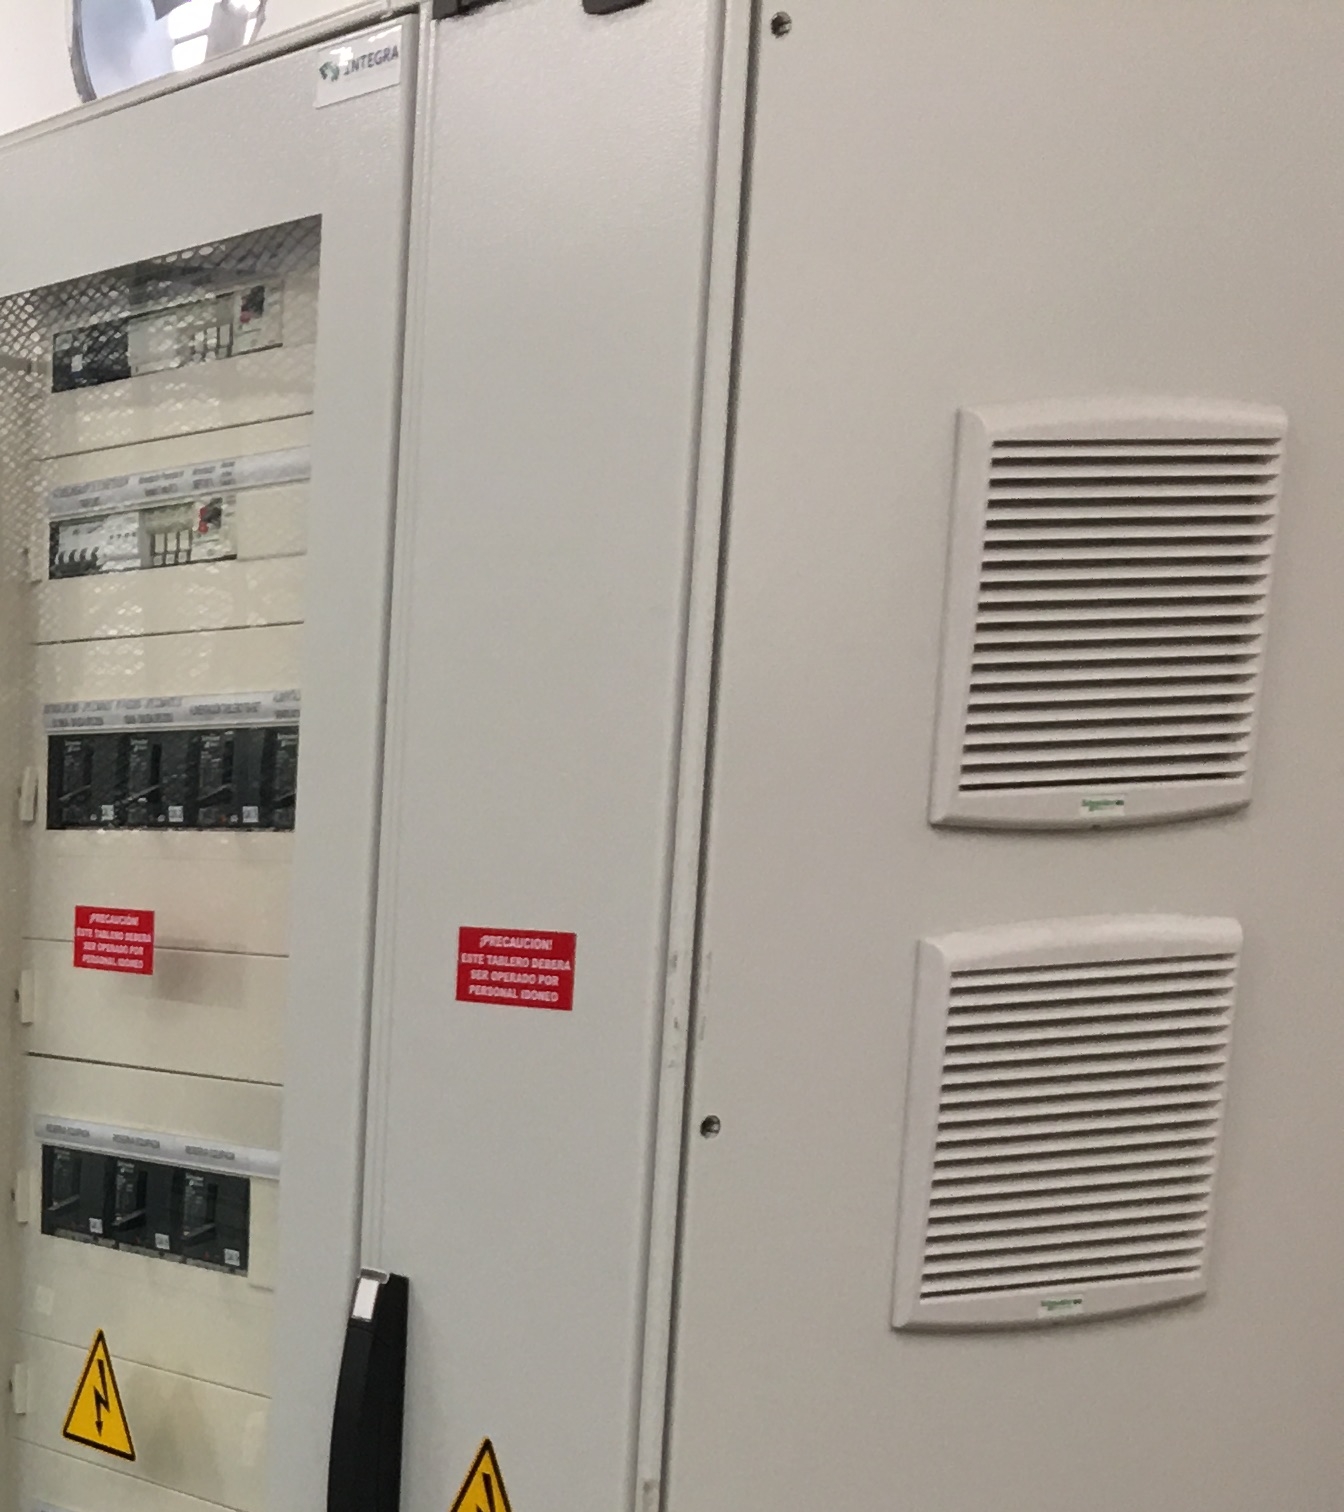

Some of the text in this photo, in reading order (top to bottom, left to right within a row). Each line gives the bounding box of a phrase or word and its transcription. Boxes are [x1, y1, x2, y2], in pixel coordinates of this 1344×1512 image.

[343, 45, 399, 75] INTEGRA
[461, 952, 485, 965] ESTE
[486, 954, 530, 967] TABLERO
[470, 969, 559, 986] SER OPERADO POR
[468, 985, 559, 1002] PERSONAL IDONEO
